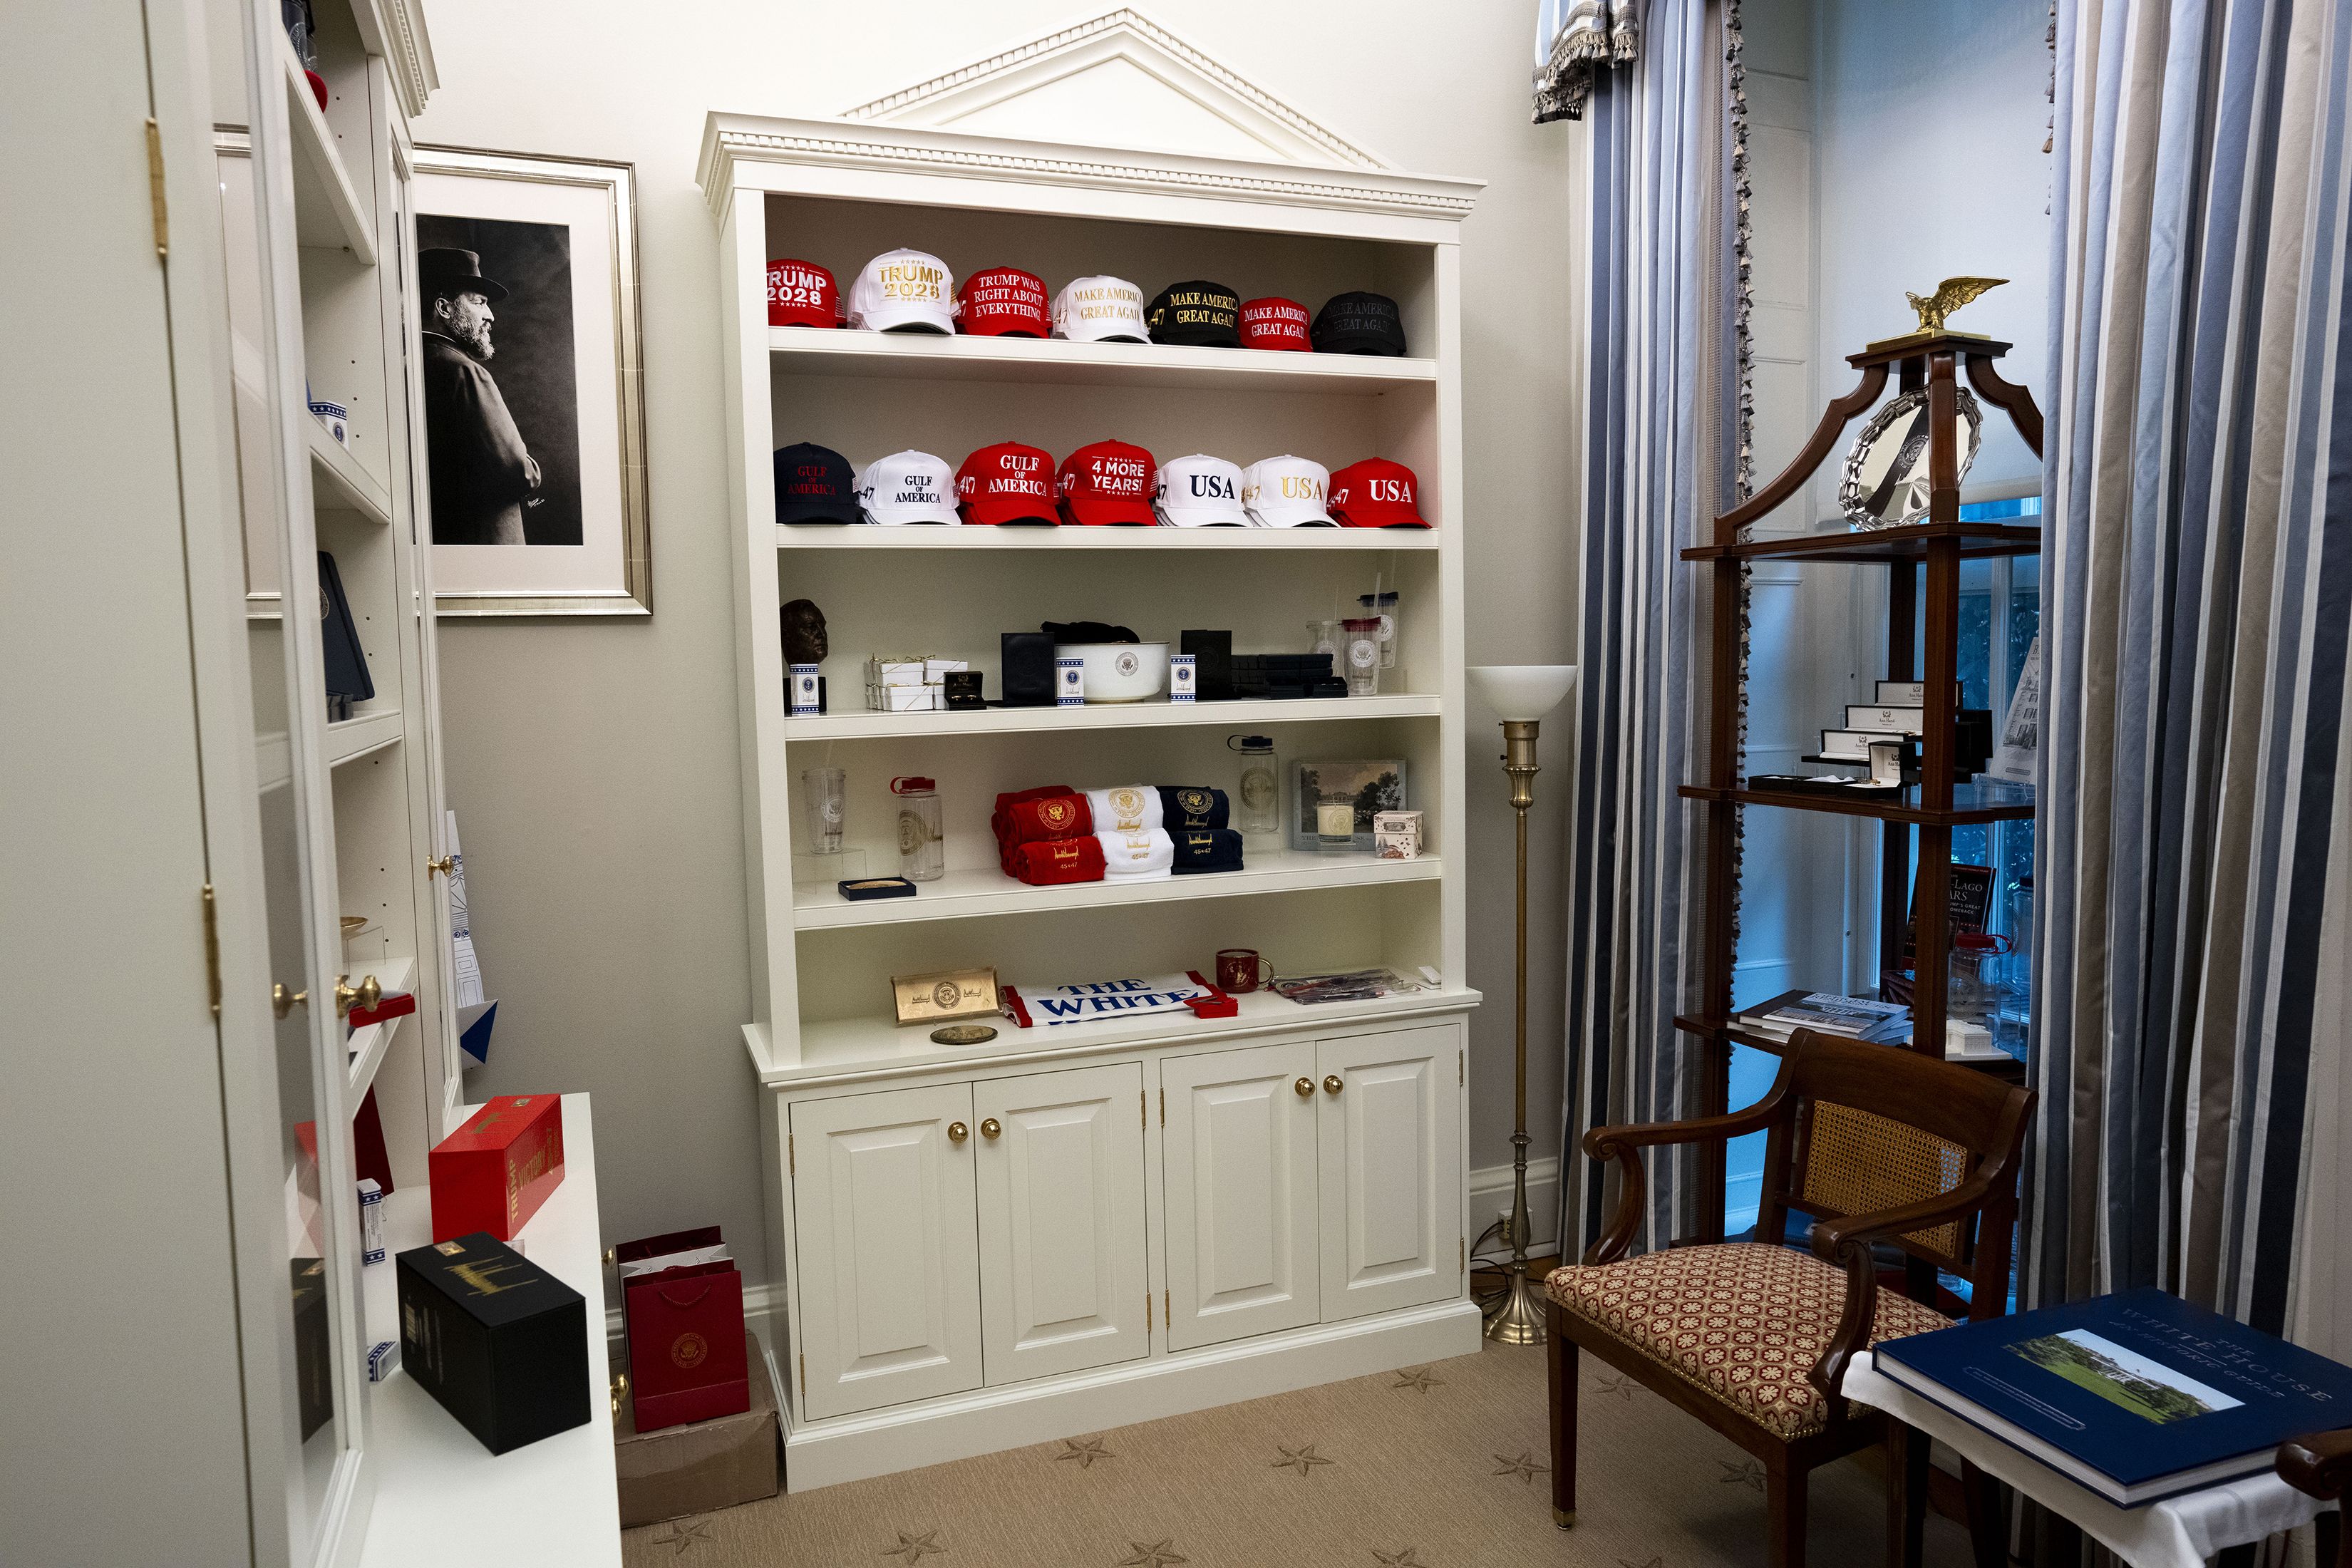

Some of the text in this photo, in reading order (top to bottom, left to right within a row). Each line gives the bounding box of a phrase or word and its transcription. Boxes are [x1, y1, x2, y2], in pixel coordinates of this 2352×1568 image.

[766, 270, 827, 291] RUMP
[878, 265, 943, 284] TRUMP
[979, 274, 1040, 292] TRUMP WAS
[768, 287, 822, 305] 2028
[884, 282, 940, 299] 2028
[974, 289, 1043, 307] RIGHT ABOUT
[1074, 287, 1141, 304] MAKE AMERIC
[1170, 292, 1201, 306] MAKE
[1080, 305, 1115, 320] GREAT
[1151, 309, 1165, 325] 47
[1177, 310, 1209, 324] GREAT
[1244, 307, 1272, 321] MAKE
[1252, 323, 1281, 337] GREAT
[798, 466, 827, 477] GULF
[1000, 455, 1040, 471] GULF
[1092, 460, 1145, 477] 4 MORE
[904, 475, 933, 486] GULF
[1015, 470, 1026, 479] OF
[1063, 473, 1075, 490] 47
[788, 483, 837, 496] AMERICA
[988, 478, 1046, 497] AMERICA
[1092, 475, 1143, 492] YEARS!
[1190, 475, 1234, 500] USA
[1281, 477, 1322, 501] USA
[1368, 480, 1412, 502] USA
[862, 486, 875, 500] 47
[895, 492, 941, 503] AMERICA
[1951, 879, 1983, 892] -LAGO
[1057, 979, 1152, 996] THE
[1037, 989, 1199, 1017] WHITE
[509, 1159, 518, 1223] TRUMP
[2122, 1308, 2333, 1402] WHITE HOUSE
[2215, 1339, 2255, 1355] THE
[2139, 1332, 2221, 1369] HISTORIC
[2223, 1370, 2286, 1398] GUIDE
